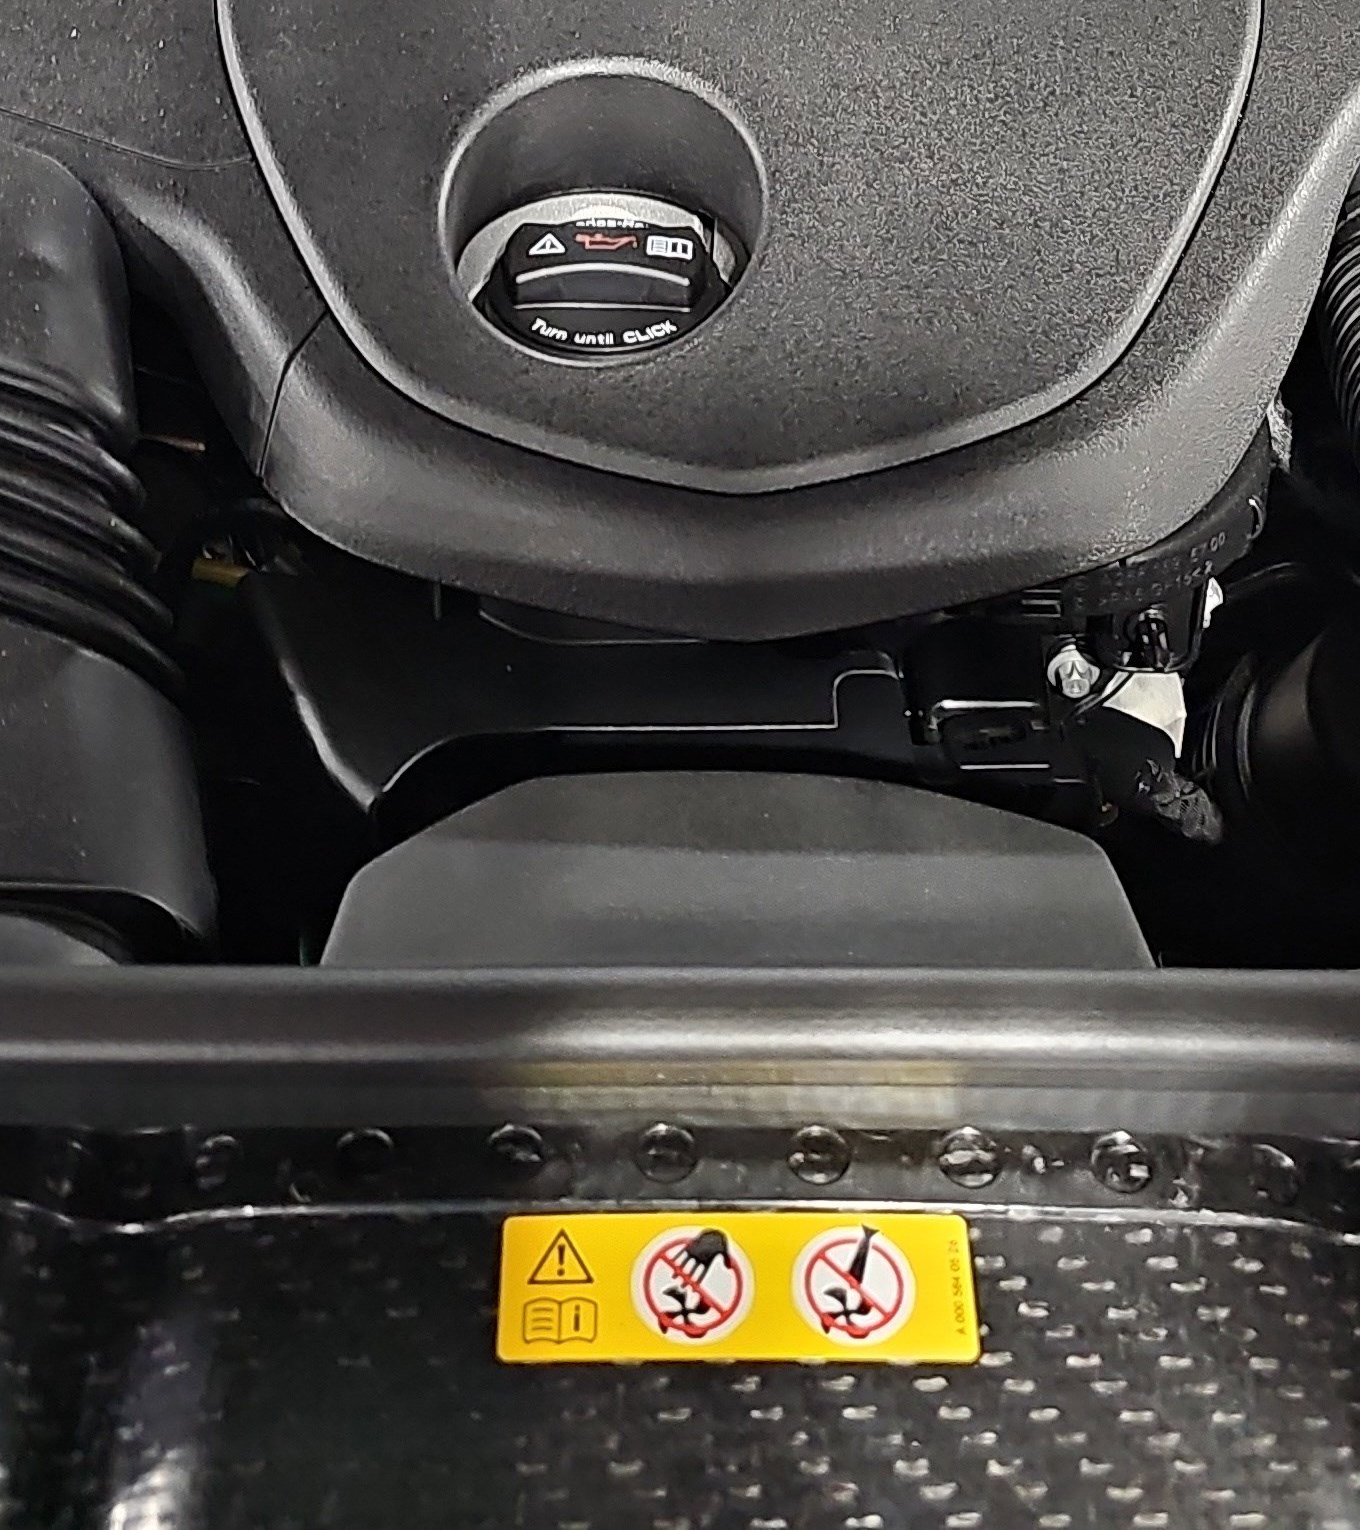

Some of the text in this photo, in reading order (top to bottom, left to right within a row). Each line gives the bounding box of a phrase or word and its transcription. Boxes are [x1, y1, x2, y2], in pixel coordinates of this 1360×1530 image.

[531, 317, 678, 345] Turn until CLICK
